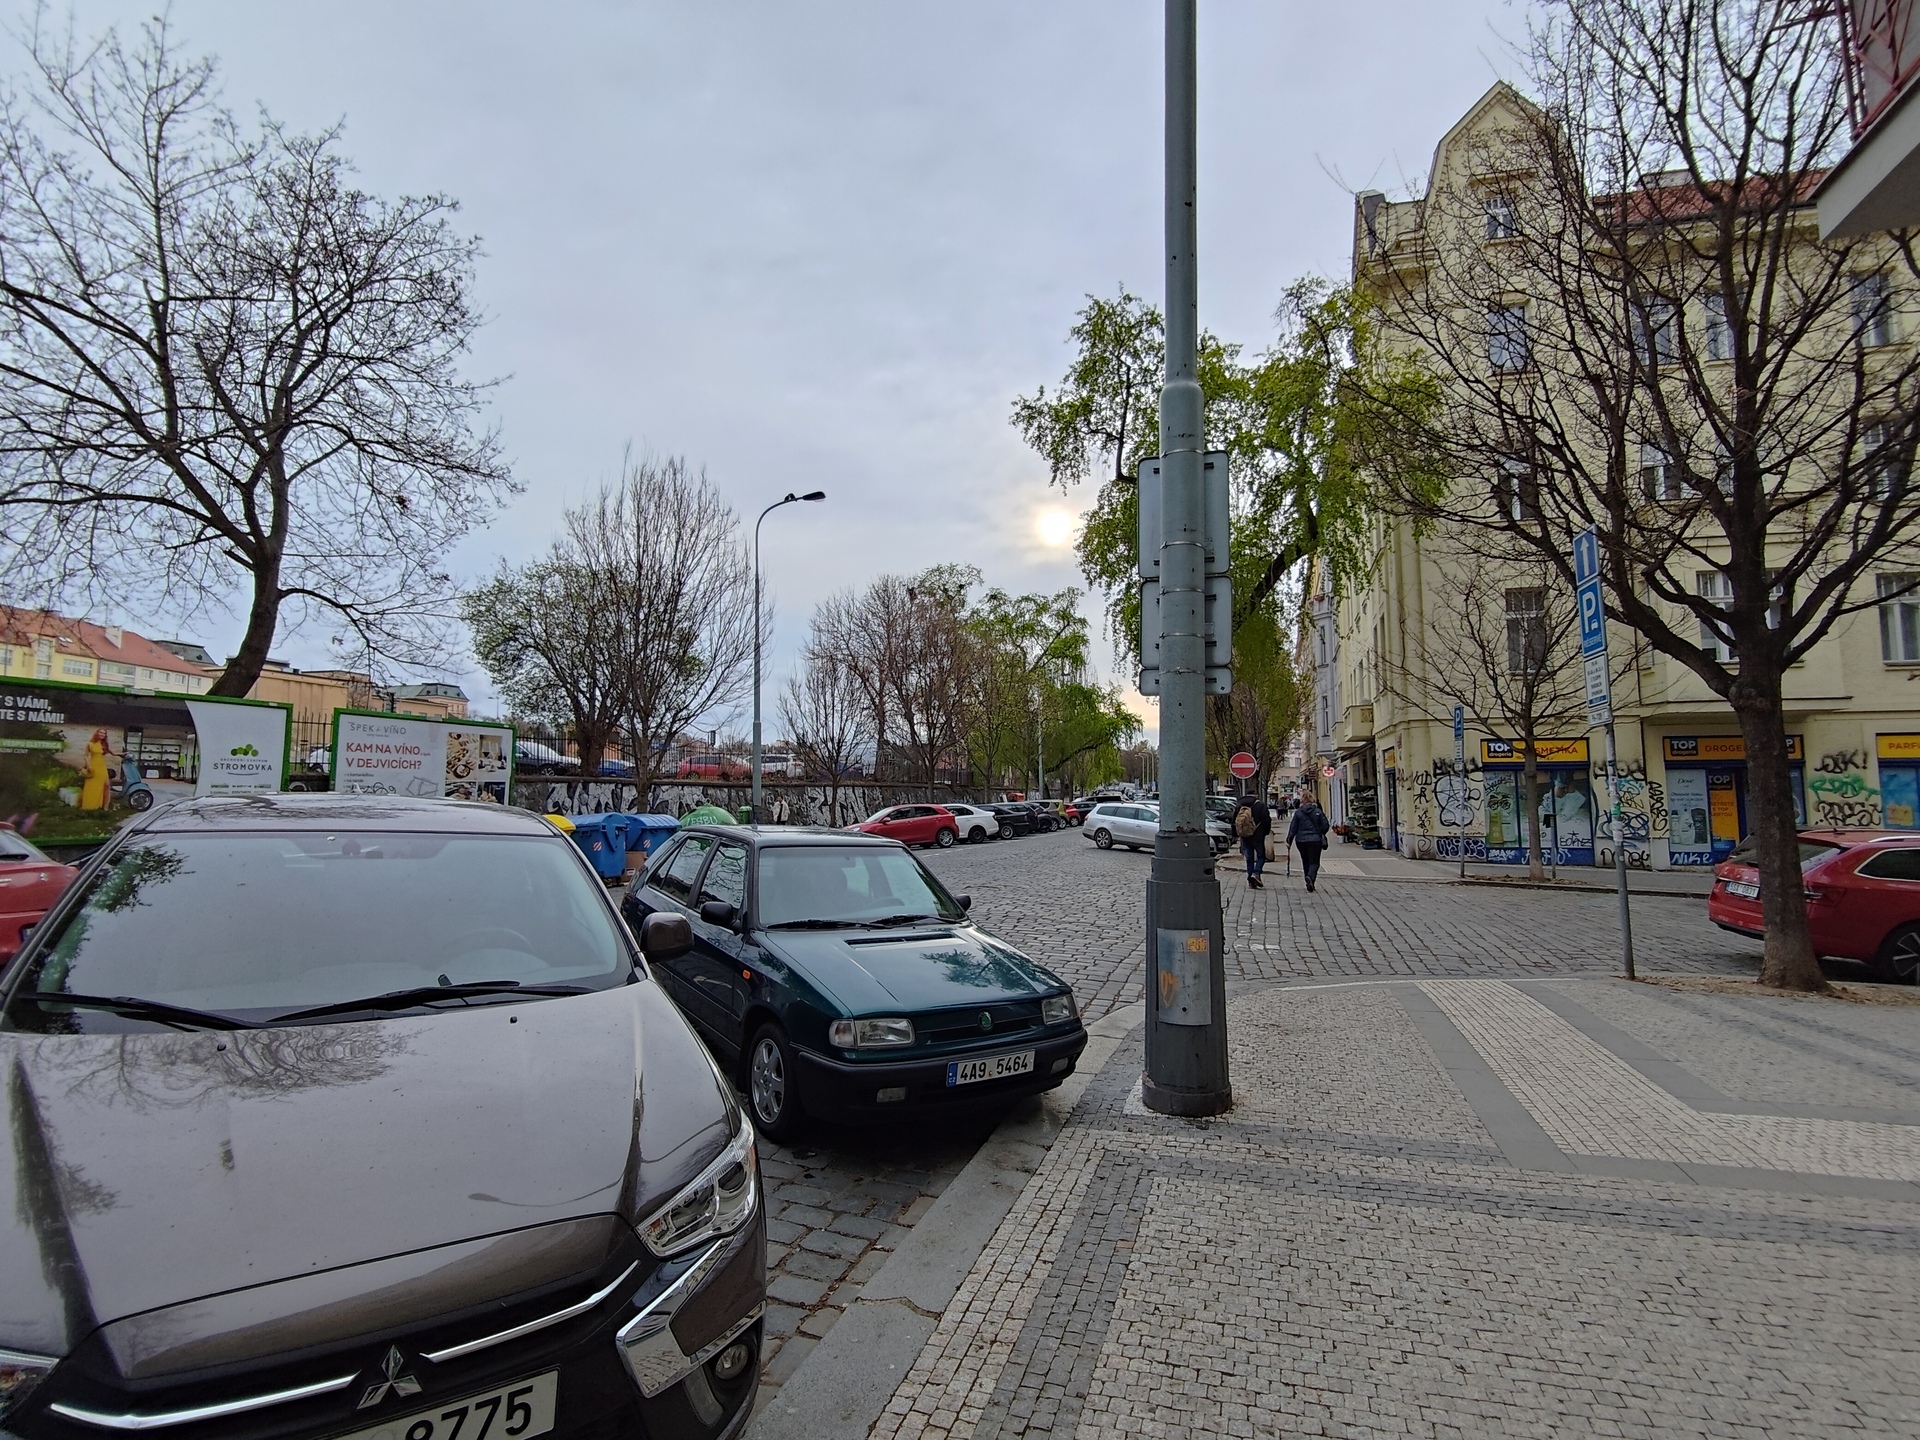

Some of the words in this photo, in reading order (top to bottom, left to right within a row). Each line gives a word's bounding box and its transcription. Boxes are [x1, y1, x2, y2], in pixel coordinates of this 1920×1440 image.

[1582, 591, 1596, 634] P
[4, 695, 14, 707] S
[16, 695, 52, 711] VÁMI,
[16, 710, 26, 721] S
[28, 710, 65, 724] NÁMI!
[346, 742, 373, 754] KAM
[375, 743, 392, 755] NA
[394, 743, 420, 756] VÍNO
[1671, 740, 1697, 750] TOP
[1704, 744, 1743, 753] DROGE
[1888, 742, 1920, 750] PARF
[213, 762, 273, 771] STROMOVKA
[345, 757, 355, 768] V
[357, 757, 422, 770] DEJVICÍCH?
[960, 1062, 987, 1081] 4A9
[996, 1054, 1028, 1075] 5464
